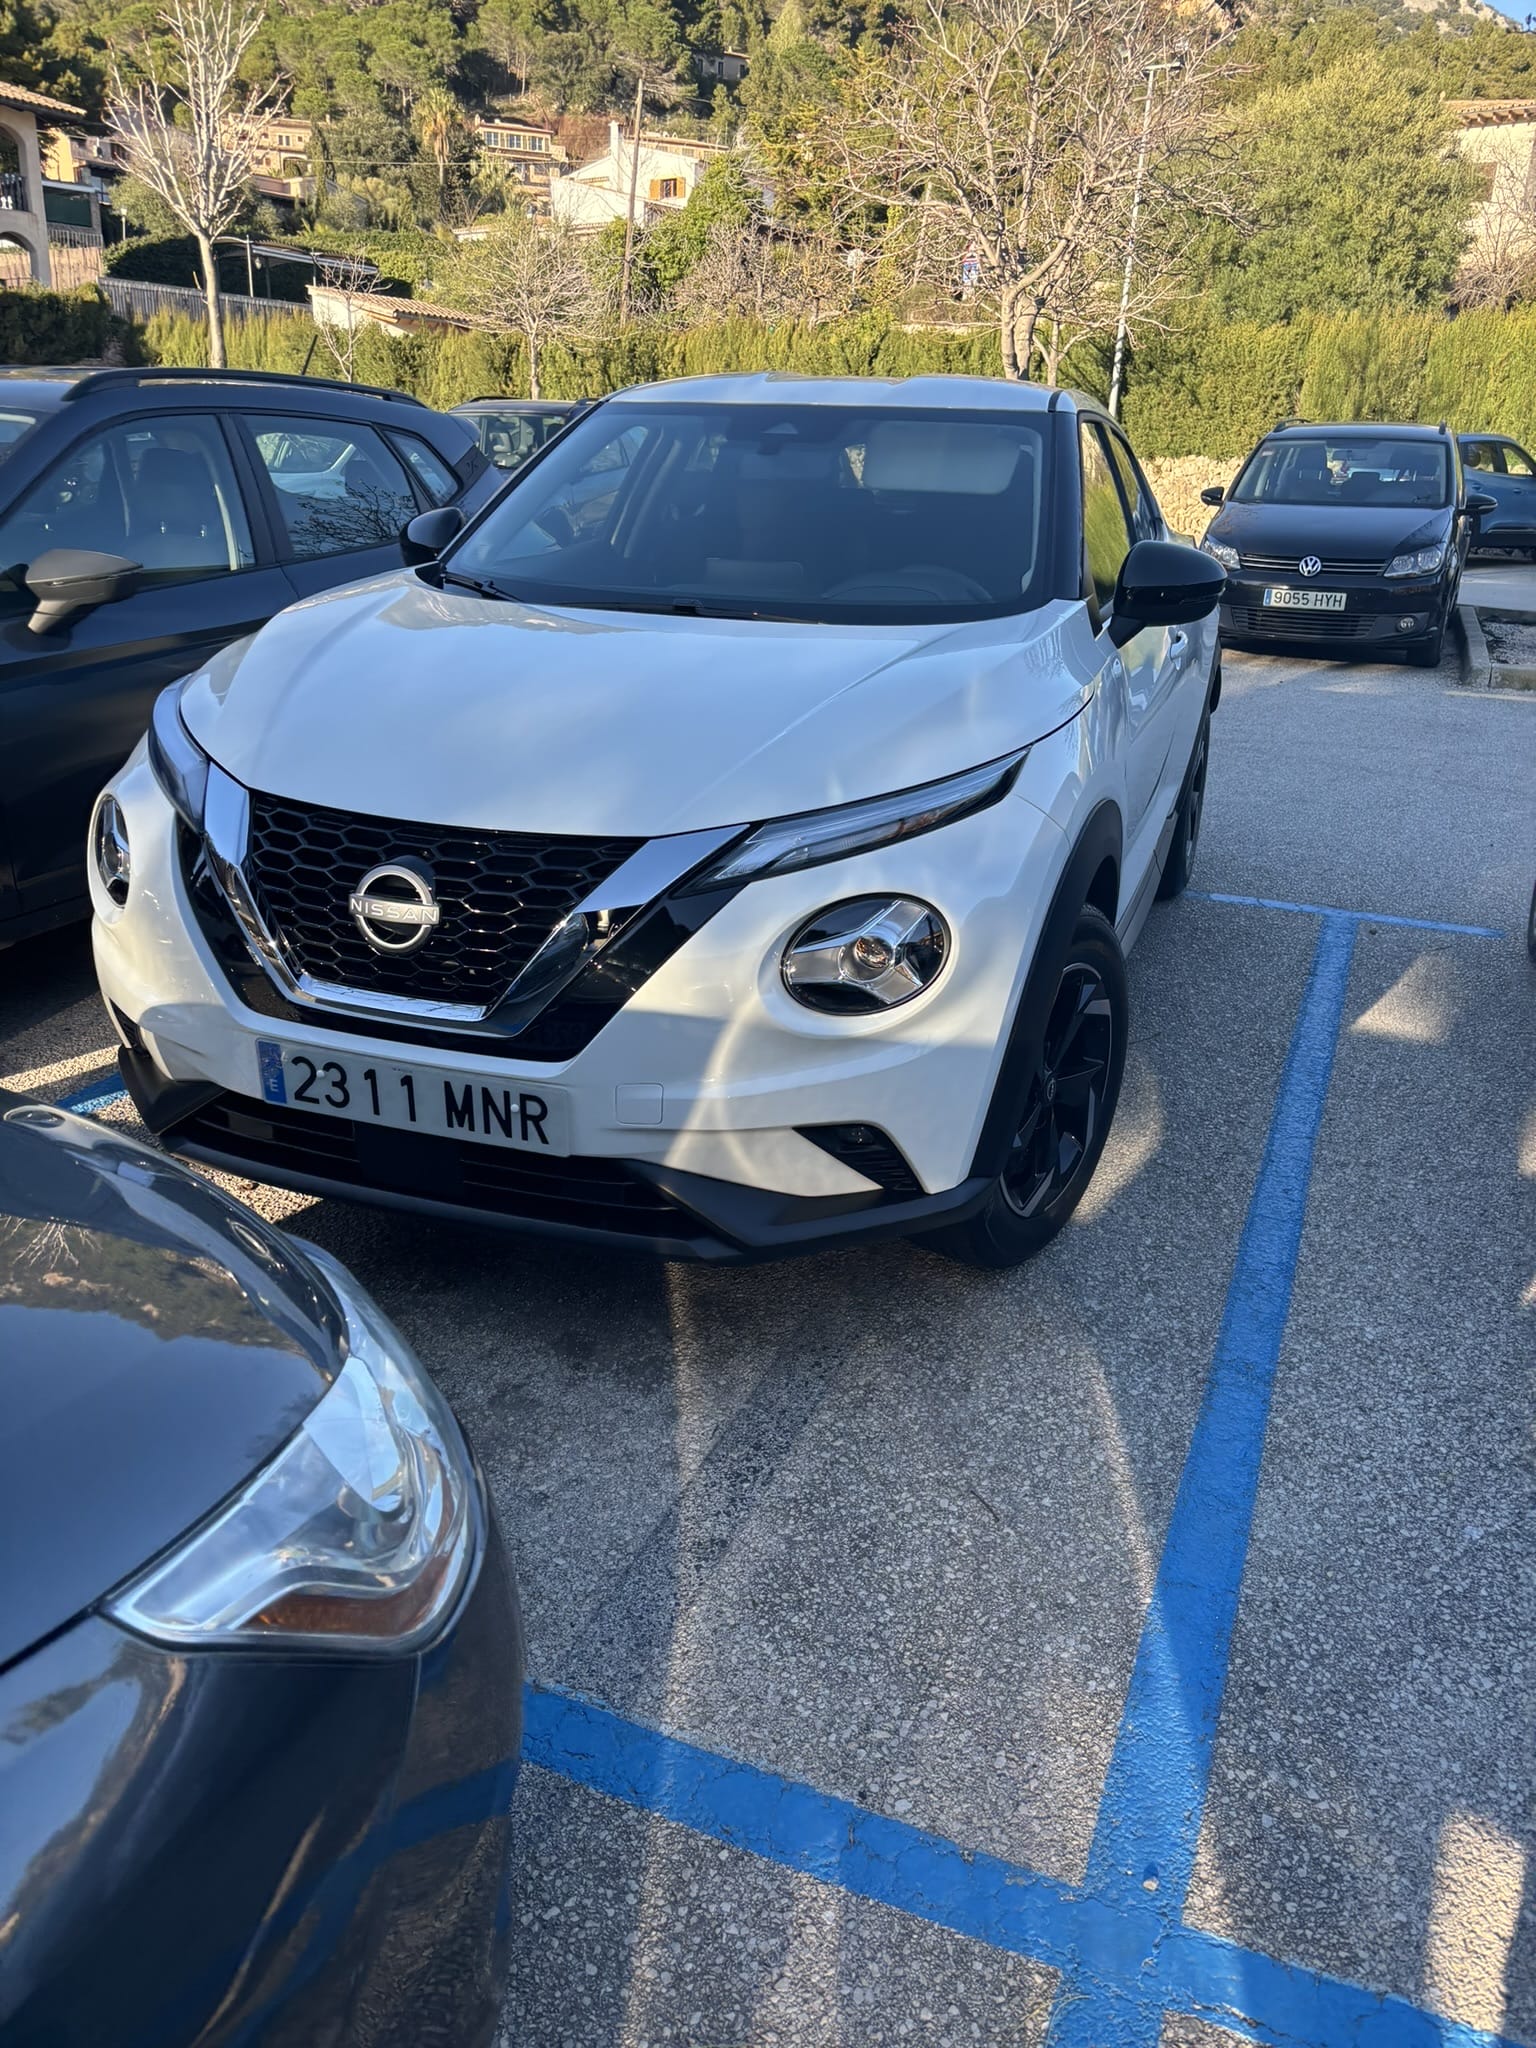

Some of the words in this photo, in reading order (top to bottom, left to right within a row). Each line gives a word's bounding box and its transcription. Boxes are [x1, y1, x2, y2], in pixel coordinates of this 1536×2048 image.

[1274, 591, 1309, 605] 9055
[1314, 593, 1343, 608] HYH
[351, 898, 437, 922] NISSAN
[291, 1056, 416, 1122] 2311
[444, 1080, 549, 1144] MNR
